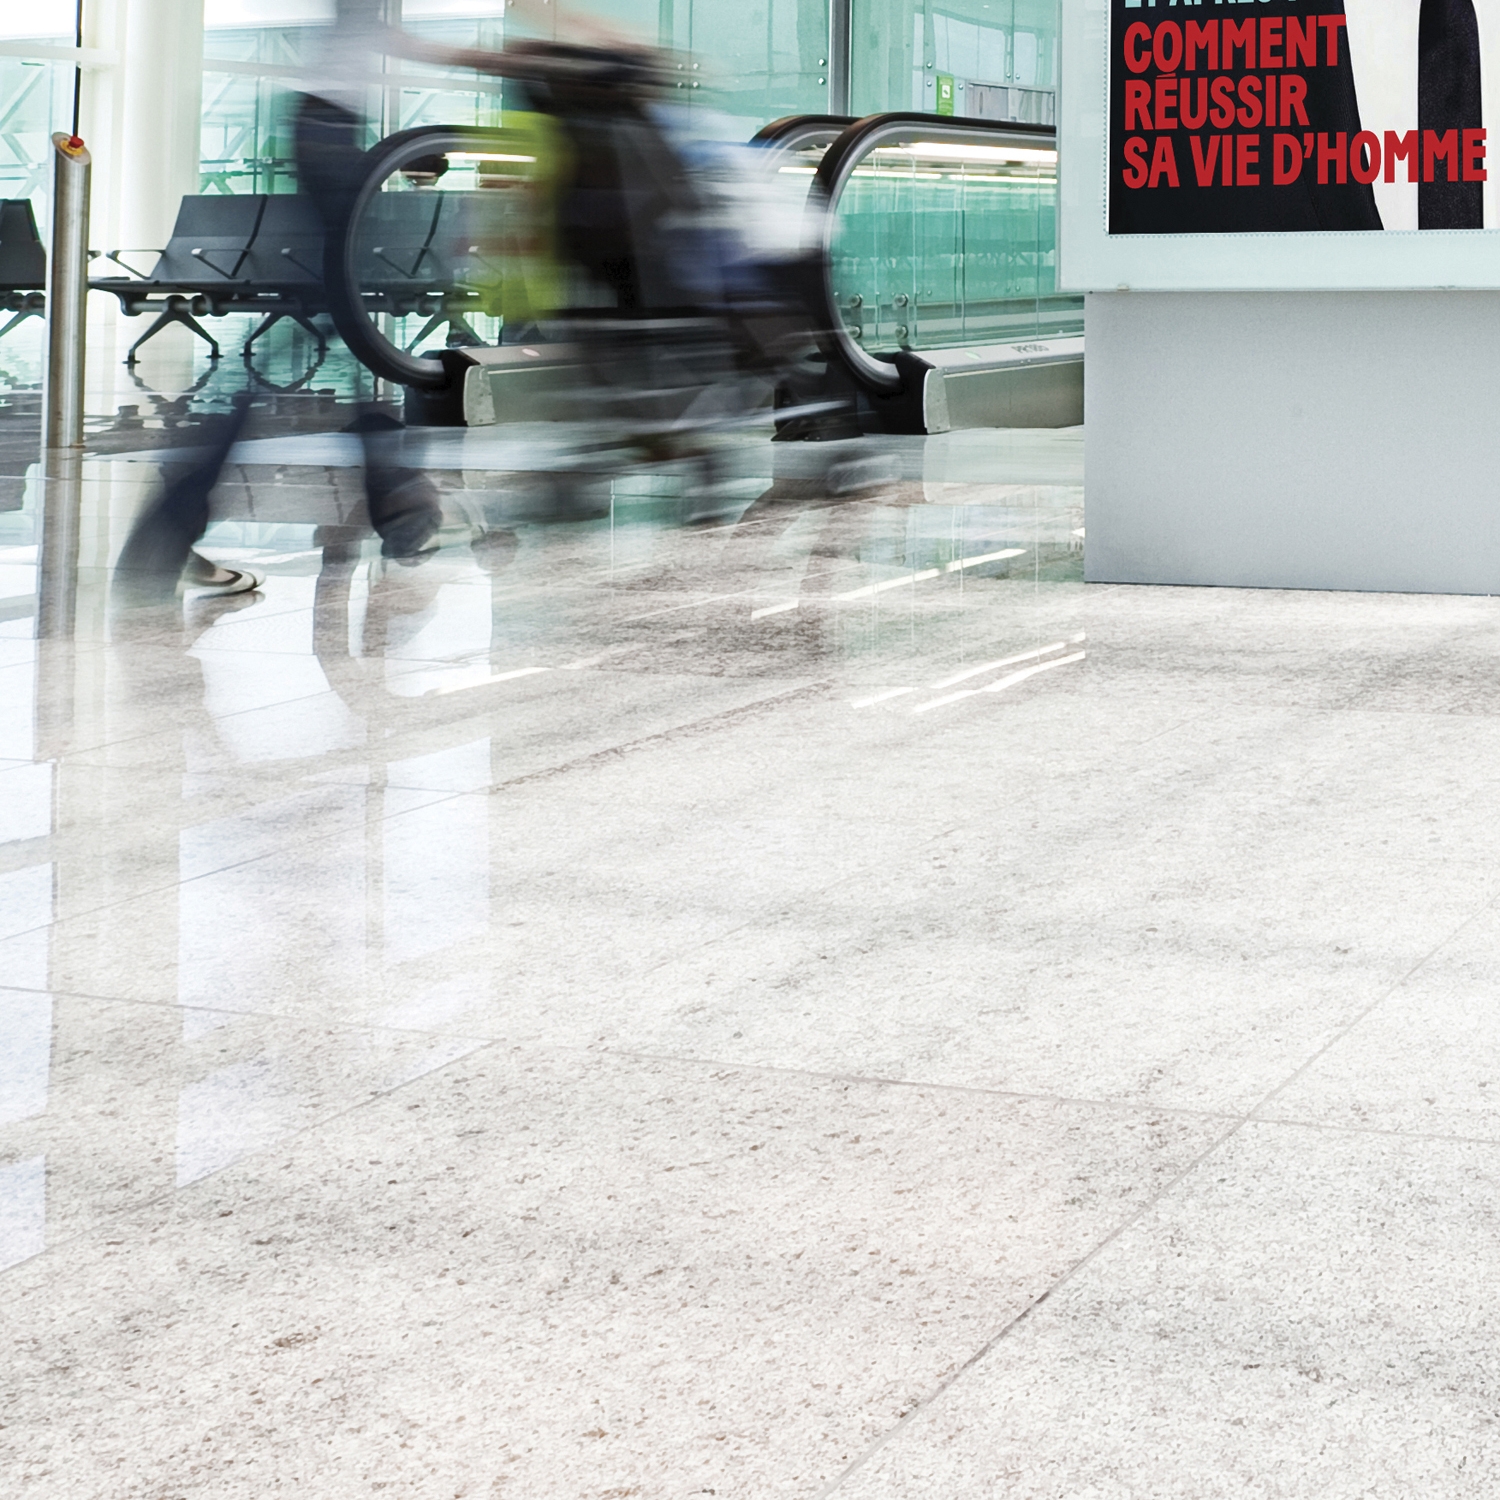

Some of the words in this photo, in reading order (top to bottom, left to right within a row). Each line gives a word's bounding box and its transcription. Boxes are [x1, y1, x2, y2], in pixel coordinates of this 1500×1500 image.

[1123, 13, 1346, 74] COMMENT
[1124, 72, 1310, 131] RÉUSSIR
[1122, 135, 1180, 189] SA
[1190, 134, 1259, 187] VIE
